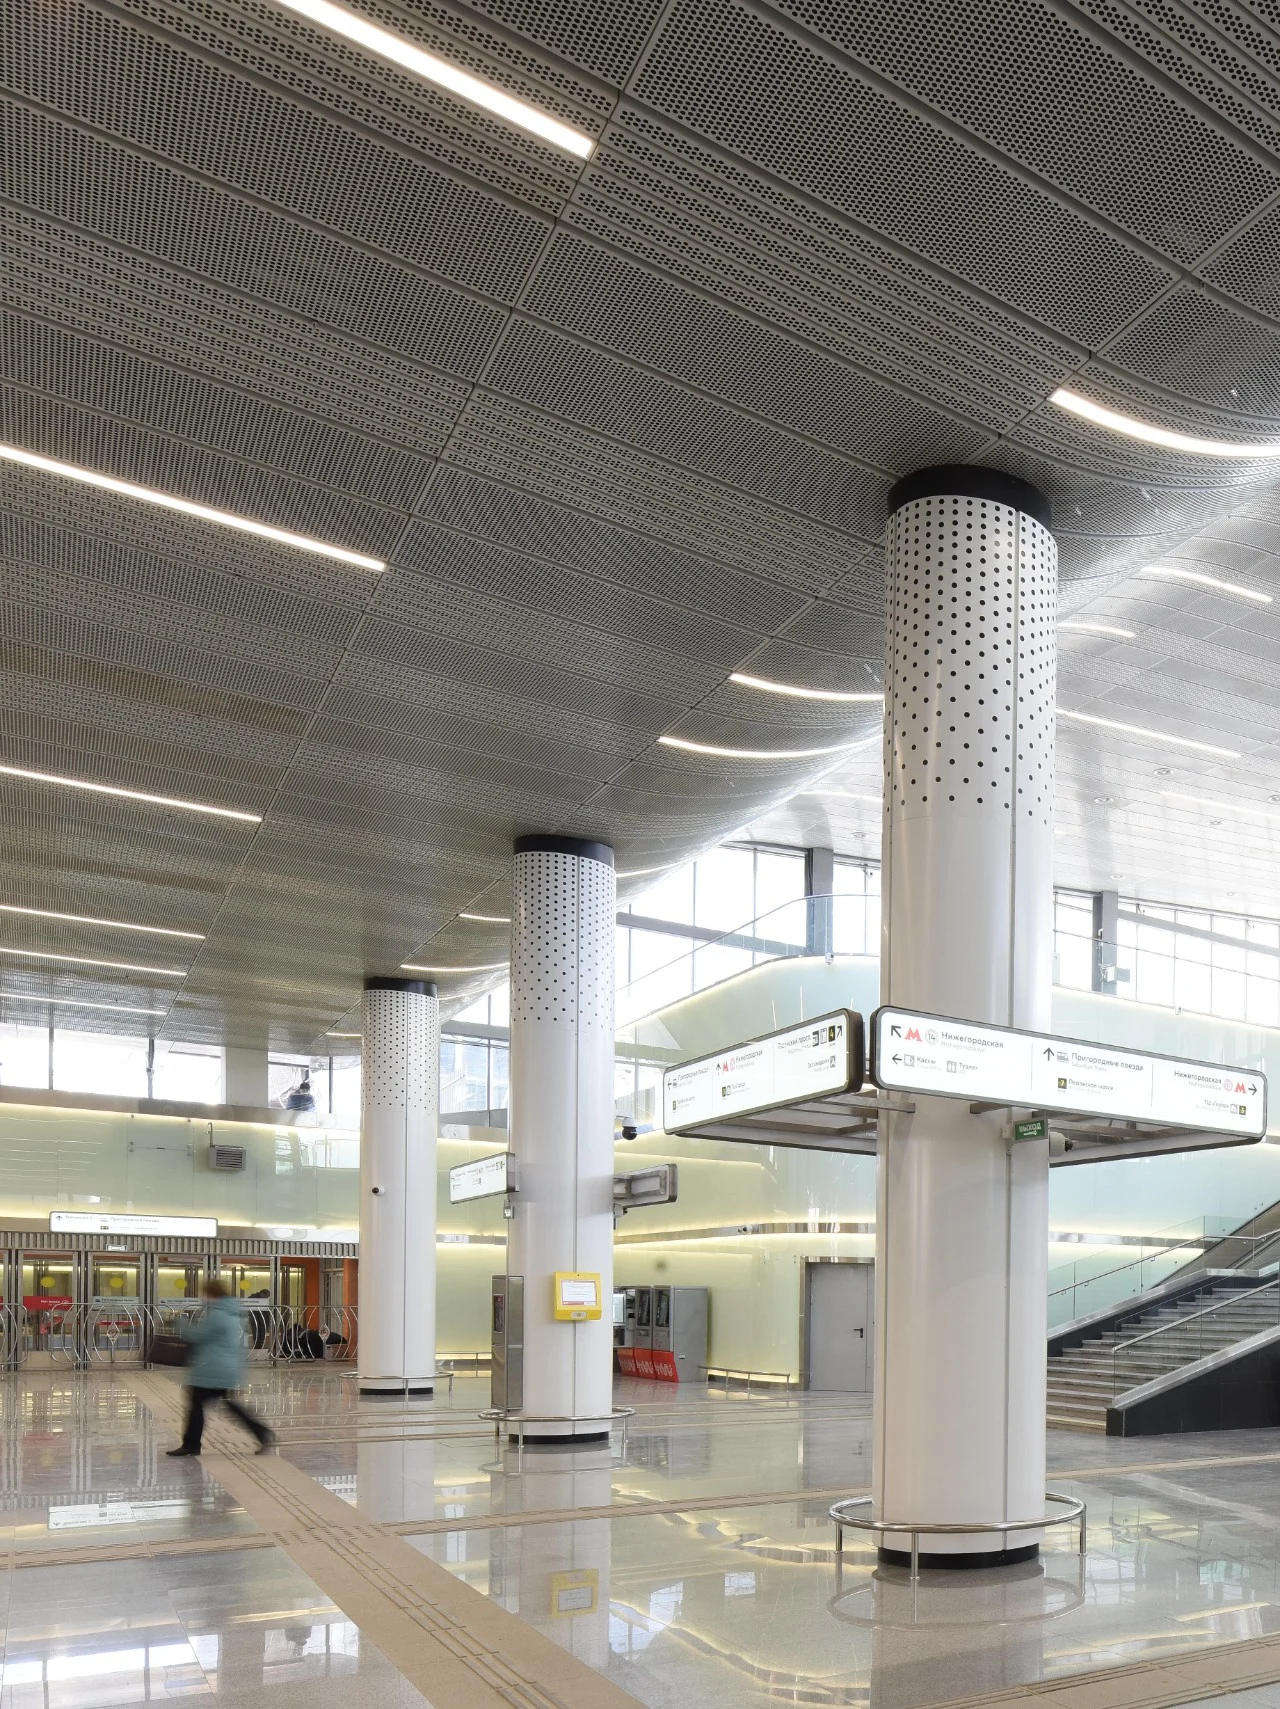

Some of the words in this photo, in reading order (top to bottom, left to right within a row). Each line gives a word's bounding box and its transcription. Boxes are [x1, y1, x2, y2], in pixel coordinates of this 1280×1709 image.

[941, 1031, 1004, 1049] Нижегородская
[916, 1056, 936, 1065] Кассы
[958, 1062, 979, 1071] Туалет
[1072, 1052, 1119, 1067] Пригородные
[1120, 1061, 1144, 1072] поезда
[1173, 1070, 1222, 1085] Нижегородская
[1019, 1123, 1041, 1132] ВЫХОД
